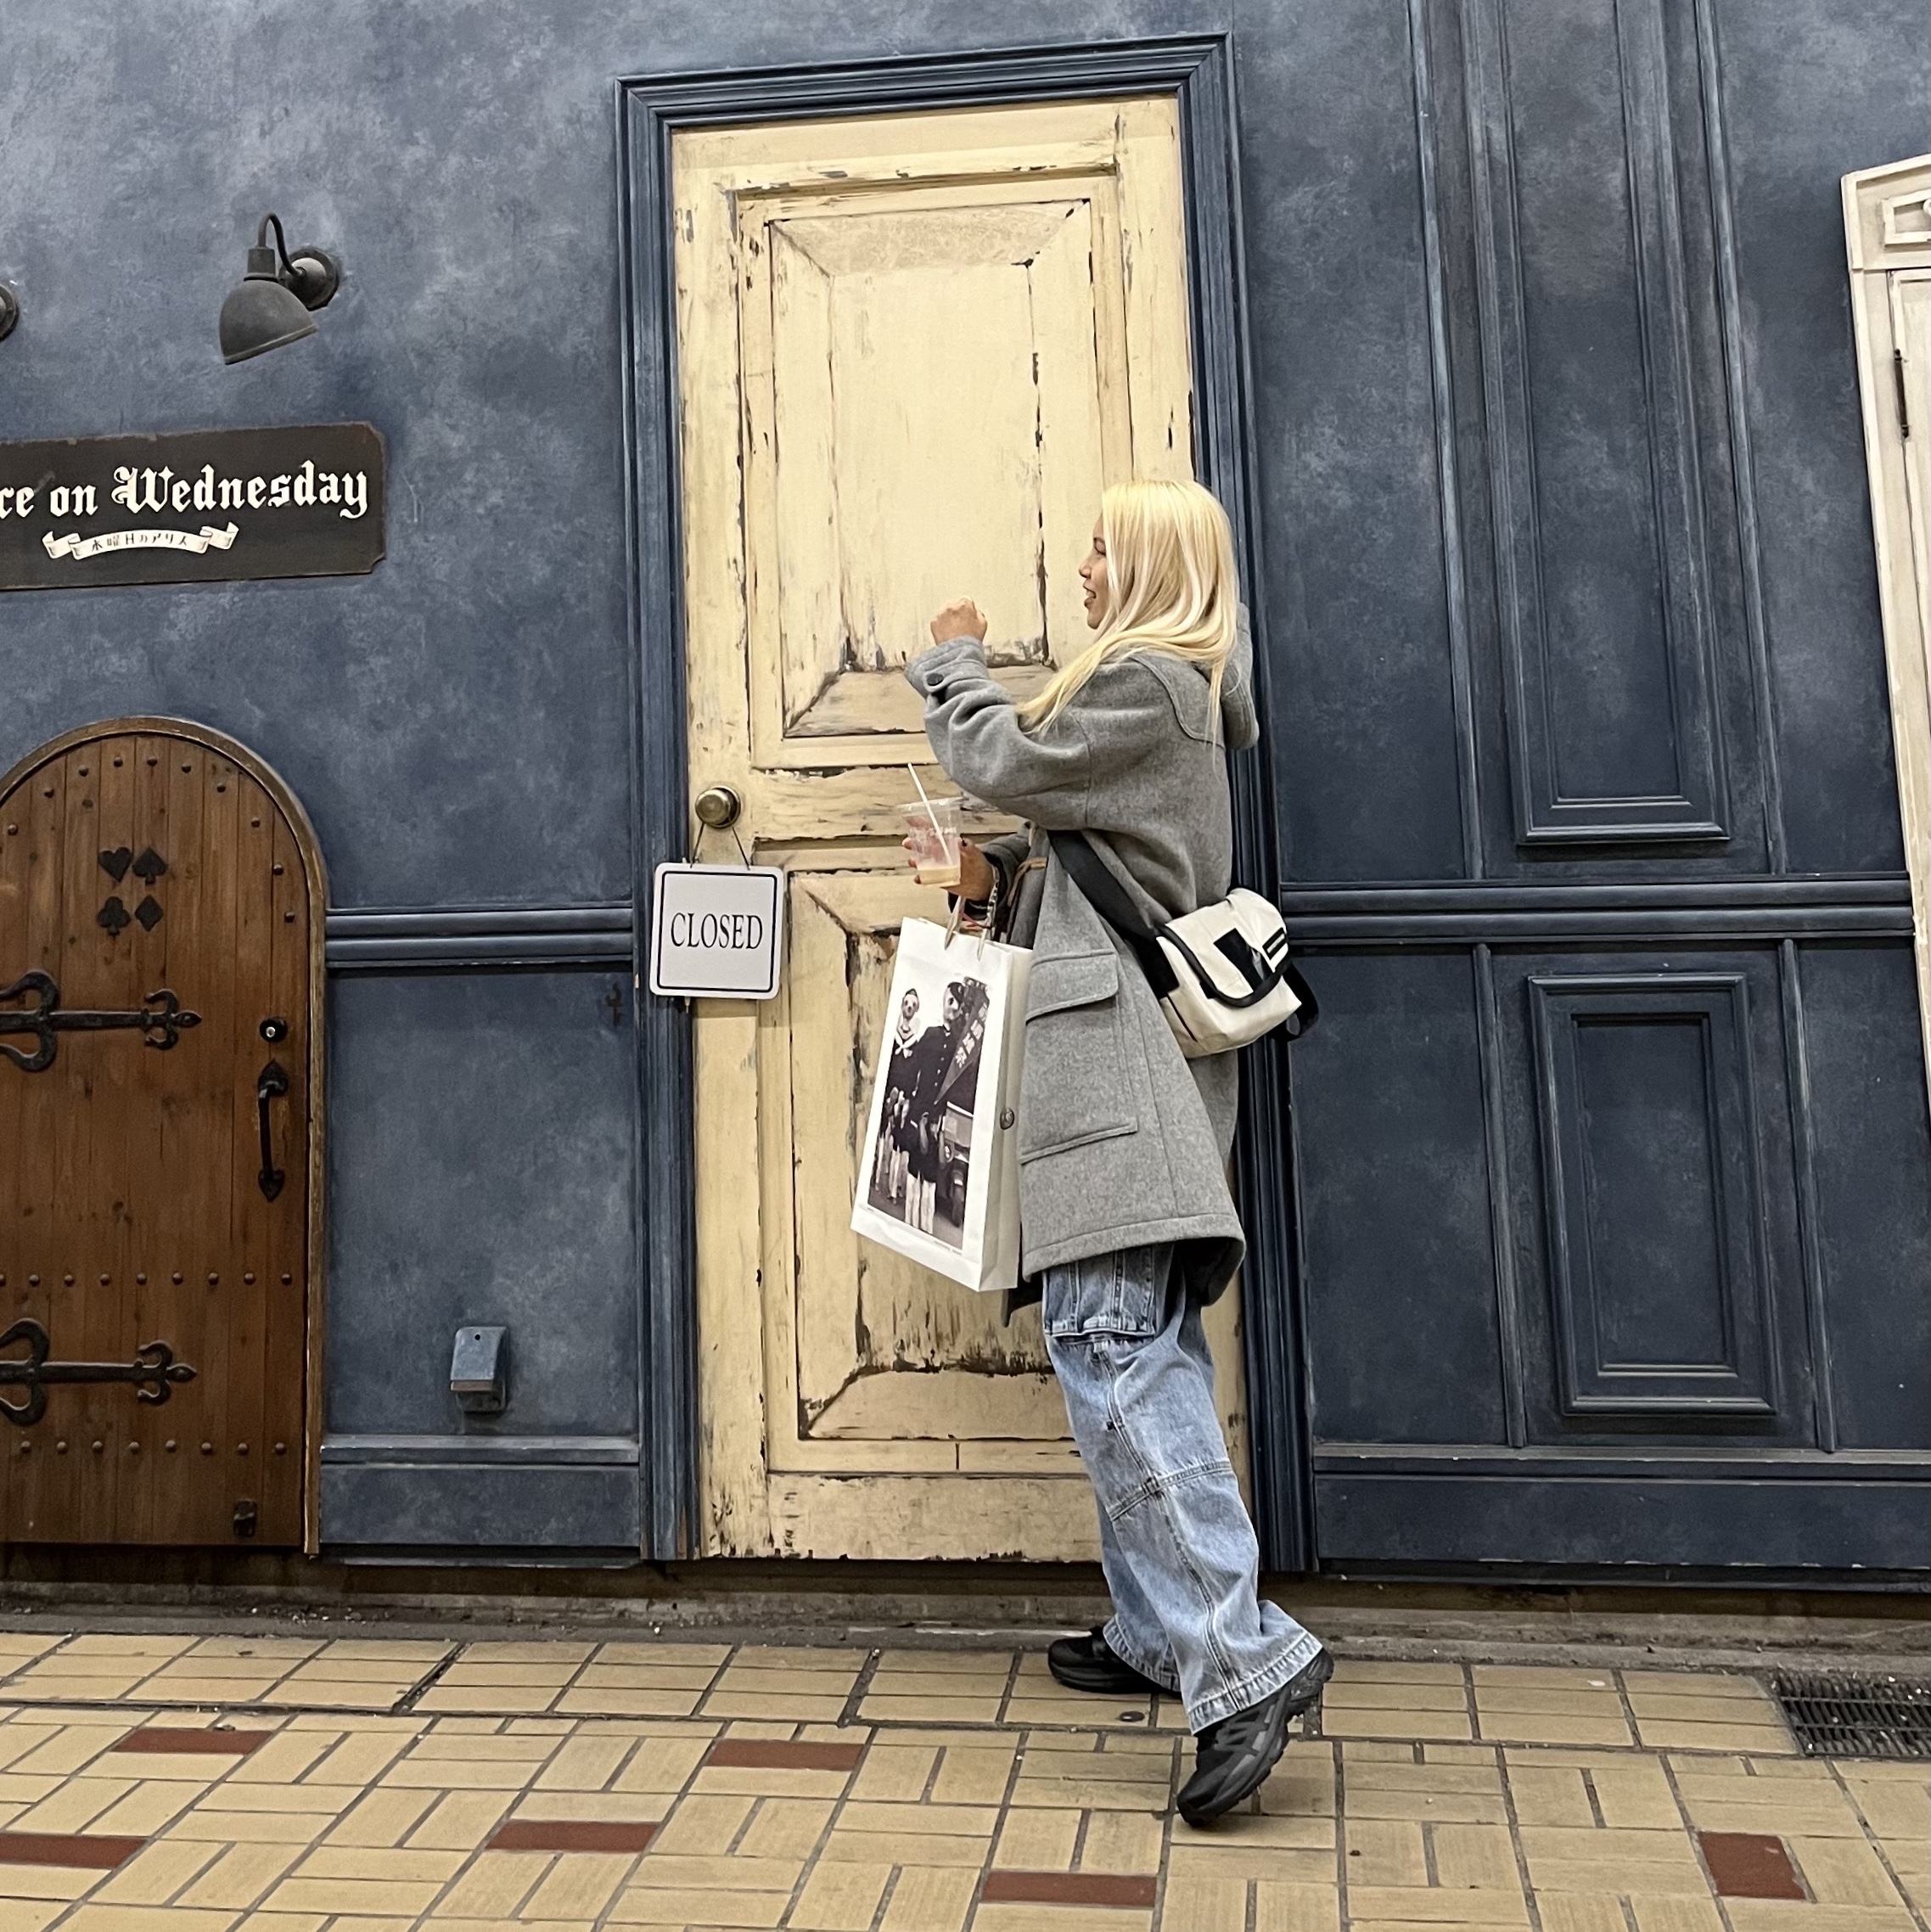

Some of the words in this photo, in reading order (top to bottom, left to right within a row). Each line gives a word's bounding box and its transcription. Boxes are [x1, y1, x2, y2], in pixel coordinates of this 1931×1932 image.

[49, 485, 98, 517] on
[111, 459, 368, 520] Wednesday
[671, 913, 763, 950] CLOSED
